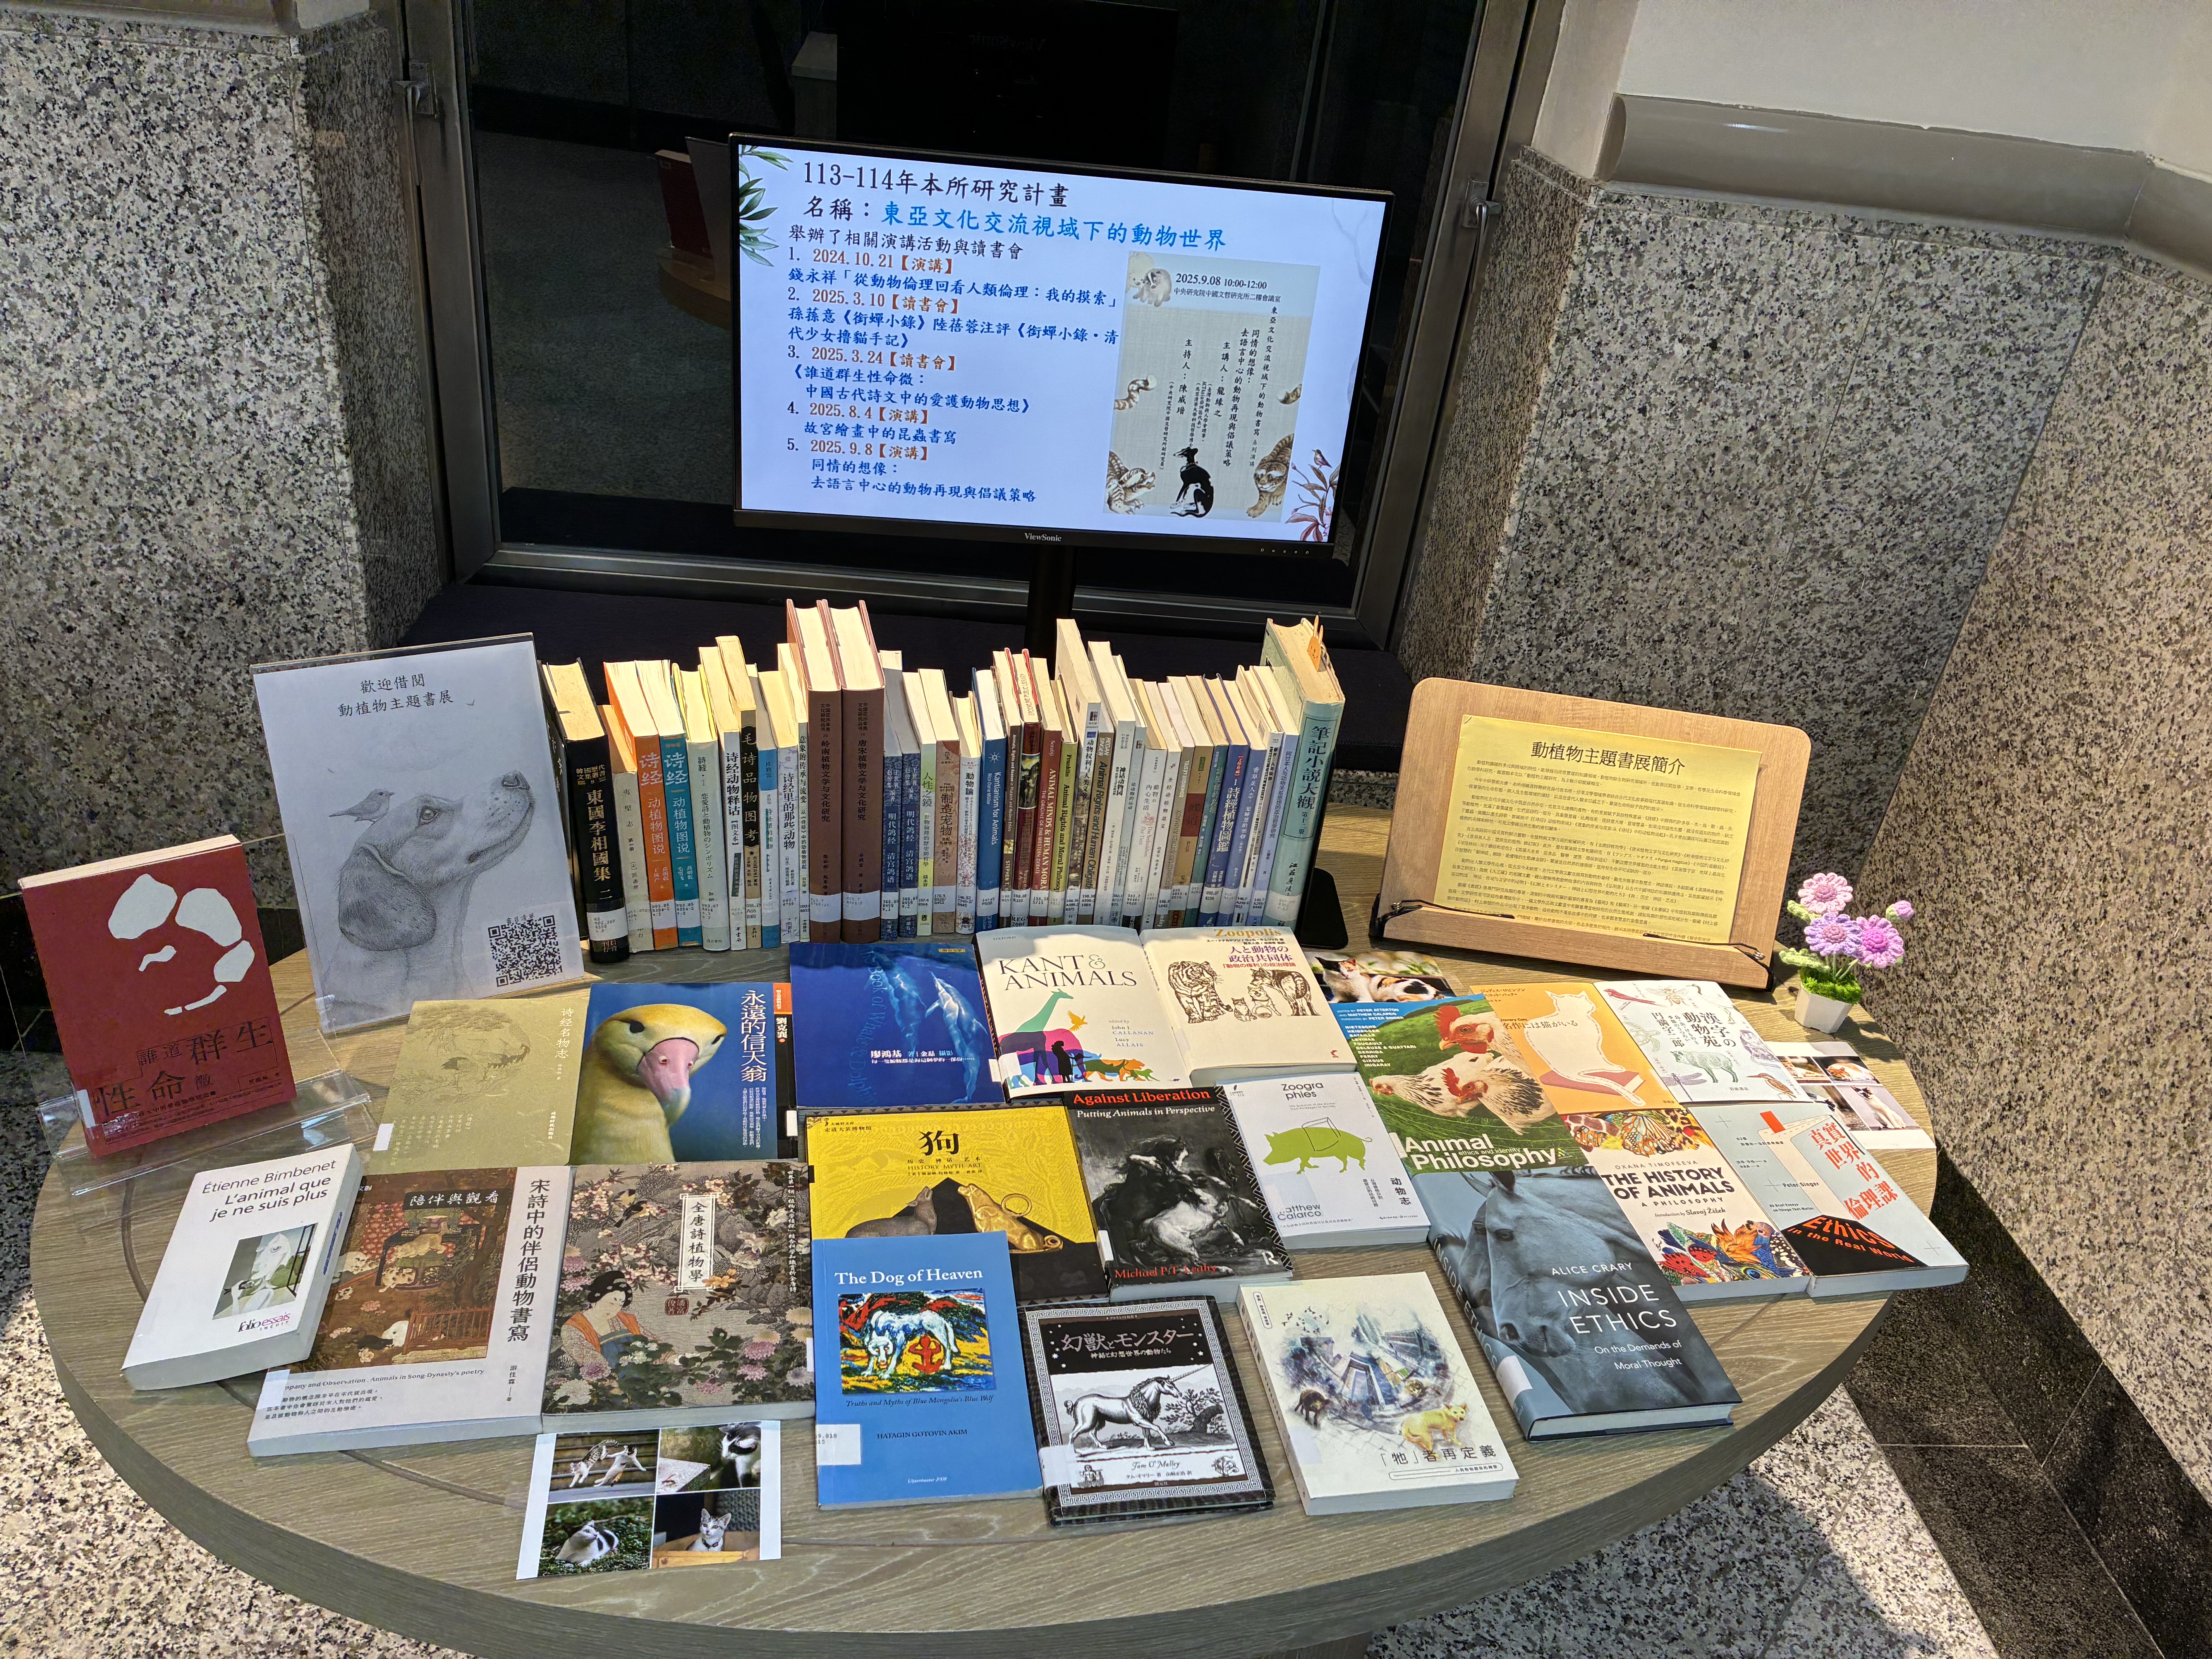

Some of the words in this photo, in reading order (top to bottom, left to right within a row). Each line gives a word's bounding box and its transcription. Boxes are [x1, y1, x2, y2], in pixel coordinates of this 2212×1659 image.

[804, 161, 1069, 208] 113-114年本所研究計畫
[788, 224, 1023, 260] 舉辦了相關演講活動與讀書會
[788, 268, 1116, 308] 錢永祥「從動物倫理回看人類倫理：我的摸索」
[1176, 273, 1221, 286] 2025.9.08
[1224, 278, 1267, 289] 10:00-12:00
[788, 327, 909, 349] 代少女擼貓手記》
[1246, 329, 1259, 383] 同情的想像：
[806, 384, 1029, 413] 中國古代詩文中的愛護動物思想》
[1223, 328, 1249, 467] 去語言中心的動物再現與倡議策略
[804, 422, 957, 445] 故宮繪畫中的昆蟲書寫
[812, 458, 898, 476] 同情的想像：
[811, 476, 1037, 503] 去語言中心的動物再現與倡議策略
[1024, 533, 1062, 541] ViewSonic
[360, 673, 426, 694] 歡迎借閱
[337, 690, 454, 717] 動植物主題書展
[639, 752, 663, 786] 诗经
[665, 752, 689, 786] 诗经
[1530, 741, 1685, 776] 動植物主題書展簡介
[726, 752, 740, 816] 诗经动物释诂
[742, 732, 758, 842] 毛诗品物图考
[858, 740, 867, 821] 唐宋植物文学与文化研究
[922, 772, 933, 807] 人性之鏡
[966, 772, 974, 795] 動物論
[1179, 776, 1187, 798] DOMINIQUE
[783, 773, 795, 850] 诗经里的那些动物
[940, 793, 953, 836] 制造宠物
[1217, 787, 1240, 852] 詩經植物圖鑑
[586, 790, 611, 881] 東國李相國集
[648, 798, 665, 854] 动植物图说
[672, 797, 690, 854] 动植物图说
[888, 812, 896, 845] 明代鸽经
[906, 810, 915, 842] 明代鸽经
[887, 852, 895, 883] 清宫鸽谱
[906, 850, 914, 881] 清宫鸽谱
[1214, 928, 1282, 938] Zoopolis
[999, 955, 1084, 974] KANT
[1088, 954, 1106, 969] &
[1228, 954, 1293, 963] 政治共同体
[1004, 970, 1137, 990] ANIMALS
[555, 1007, 575, 1059] 诗经名物志
[740, 989, 767, 1083] 永遠的信天翁
[776, 1017, 788, 1039] 劉克襄
[1503, 1020, 1578, 1029] 名作には猫がいる
[1651, 1012, 1685, 1048] 円満字二郎
[1682, 1012, 1722, 1048] 動物苑
[1701, 1012, 1736, 1048] 漢字の
[1073, 1093, 1131, 1106] Against
[1133, 1090, 1211, 1103] Liberation
[1281, 1082, 1324, 1091] Zoogra
[1286, 1091, 1317, 1100] phies
[1077, 1110, 1112, 1118] Putting
[1113, 1108, 1152, 1116] Animals
[1165, 1105, 1215, 1115] Perspective
[919, 1130, 960, 1156] 狗
[1406, 1133, 1494, 1153] Animal
[1807, 1122, 1846, 1151] 真實
[1412, 1148, 1555, 1170] Philosophy
[1824, 1140, 1861, 1171] 世界
[202, 1176, 260, 1195] Étienne
[264, 1160, 337, 1184] Bimbenet
[299, 1176, 331, 1193] que
[1602, 1173, 1642, 1186] THE
[1647, 1167, 1726, 1183] HISTORY
[1856, 1162, 1880, 1182] 的
[409, 1190, 500, 1208] 陪伴與觀看
[1390, 1177, 1411, 1205] 动物志
[1613, 1186, 1646, 1199] OF
[1648, 1180, 1735, 1198] ANIMALS
[1653, 1197, 1724, 1207] PHILOSOPHY
[1843, 1180, 1898, 1221] 倫理課
[210, 1208, 228, 1222] je
[233, 1205, 254, 1216] ne
[258, 1196, 289, 1211] suis
[293, 1188, 328, 1206] plus
[1278, 1211, 1321, 1221] Calarco
[1685, 1208, 1707, 1217] Slavoj
[1707, 1206, 1726, 1214] Žižek
[687, 1201, 708, 1283] 全唐詩植物學
[1802, 1217, 1895, 1249] Ethics
[1807, 1232, 1829, 1242] the
[1835, 1239, 1866, 1251] Real
[1869, 1247, 1915, 1263] World
[507, 1179, 551, 1343] 宋詩中的伴侶動物書寫
[1551, 1265, 1589, 1276] ALICE
[1591, 1262, 1633, 1273] CRARY
[834, 1272, 867, 1285] The
[871, 1271, 904, 1286] Dog
[907, 1269, 925, 1281] of
[926, 1268, 983, 1282] Heaven
[1433, 1237, 1464, 1297] INSIDE
[1463, 1301, 1498, 1369] ETHICS
[1556, 1284, 1659, 1308] INSIDE
[1569, 1309, 1678, 1334] ETHICS
[1061, 1328, 1194, 1353] 幻獣とモンスター
[1594, 1345, 1610, 1355] On
[1611, 1344, 1626, 1353] the
[1628, 1341, 1670, 1352] Demands
[1671, 1340, 1682, 1349] of
[1091, 1348, 1171, 1360] 神話と幻想世界の動物たち
[1614, 1360, 1643, 1370] Moral
[1644, 1357, 1683, 1369] Thought
[846, 1399, 867, 1407] Truths
[883, 1398, 904, 1407] Myths
[928, 1396, 963, 1404] Mongolia's
[980, 1395, 994, 1403] Wolf
[877, 1432, 911, 1440] HATAGIN
[1132, 1462, 1146, 1470] Tam
[1380, 1445, 1497, 1466] 「牠」者再定義
